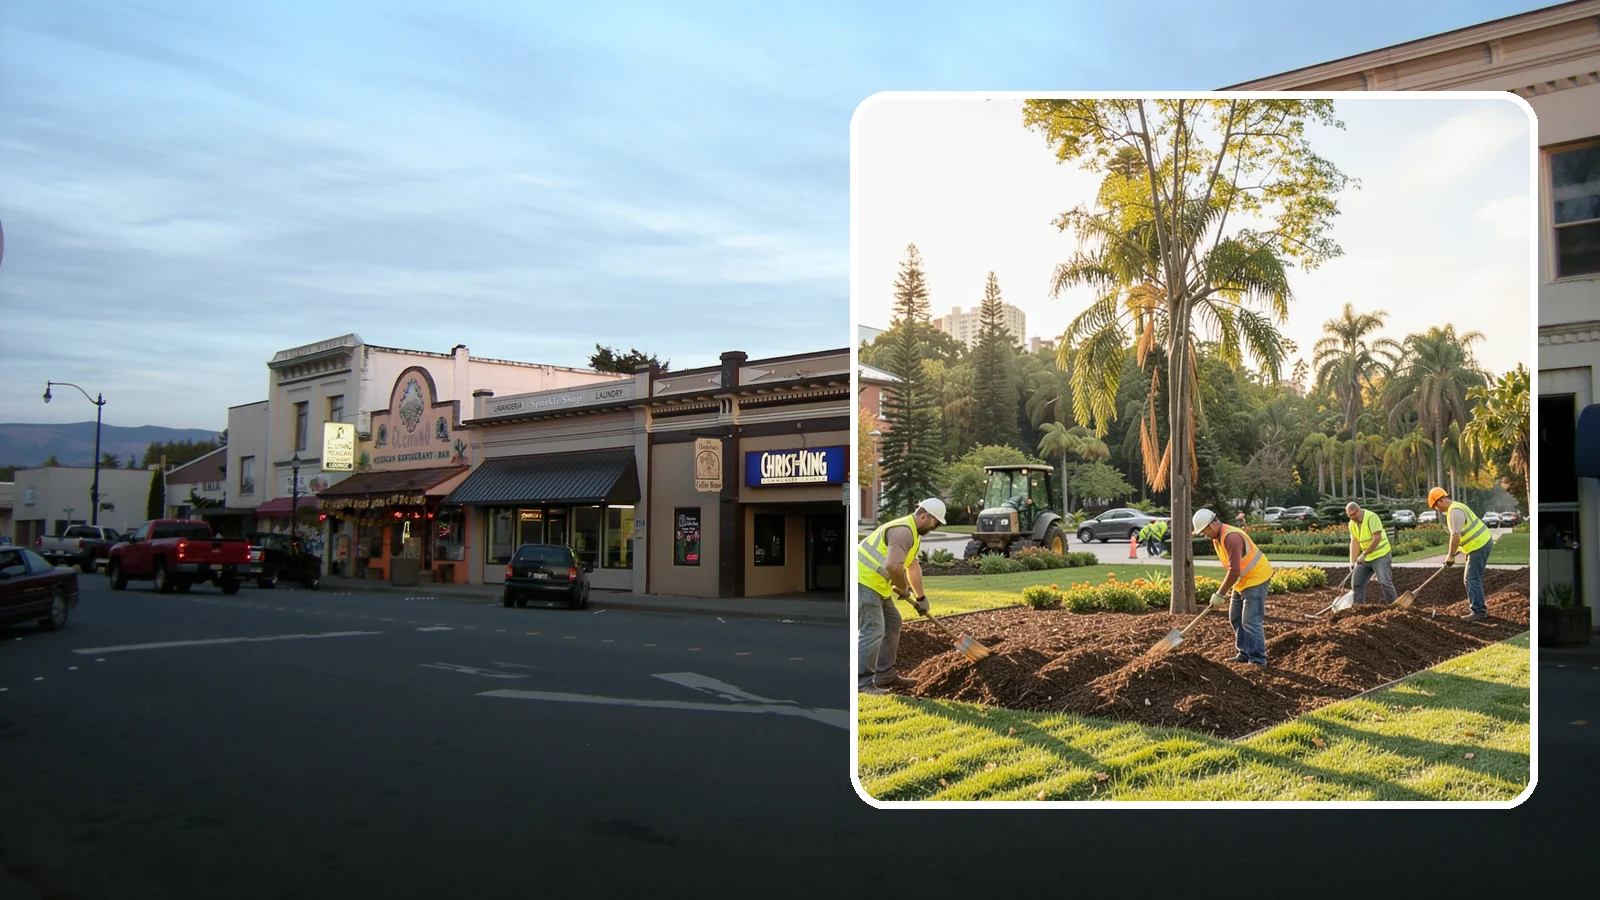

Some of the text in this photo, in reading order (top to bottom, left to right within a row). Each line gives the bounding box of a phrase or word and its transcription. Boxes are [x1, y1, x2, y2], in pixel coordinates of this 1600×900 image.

[595, 389, 624, 400] LAUNDRY
[493, 402, 523, 412] LAVANDERIA
[530, 394, 583, 409] Sparkle Shop
[373, 455, 396, 464] MEXICAN
[397, 452, 433, 462] RESTAURANT
[438, 450, 450, 459] BAR
